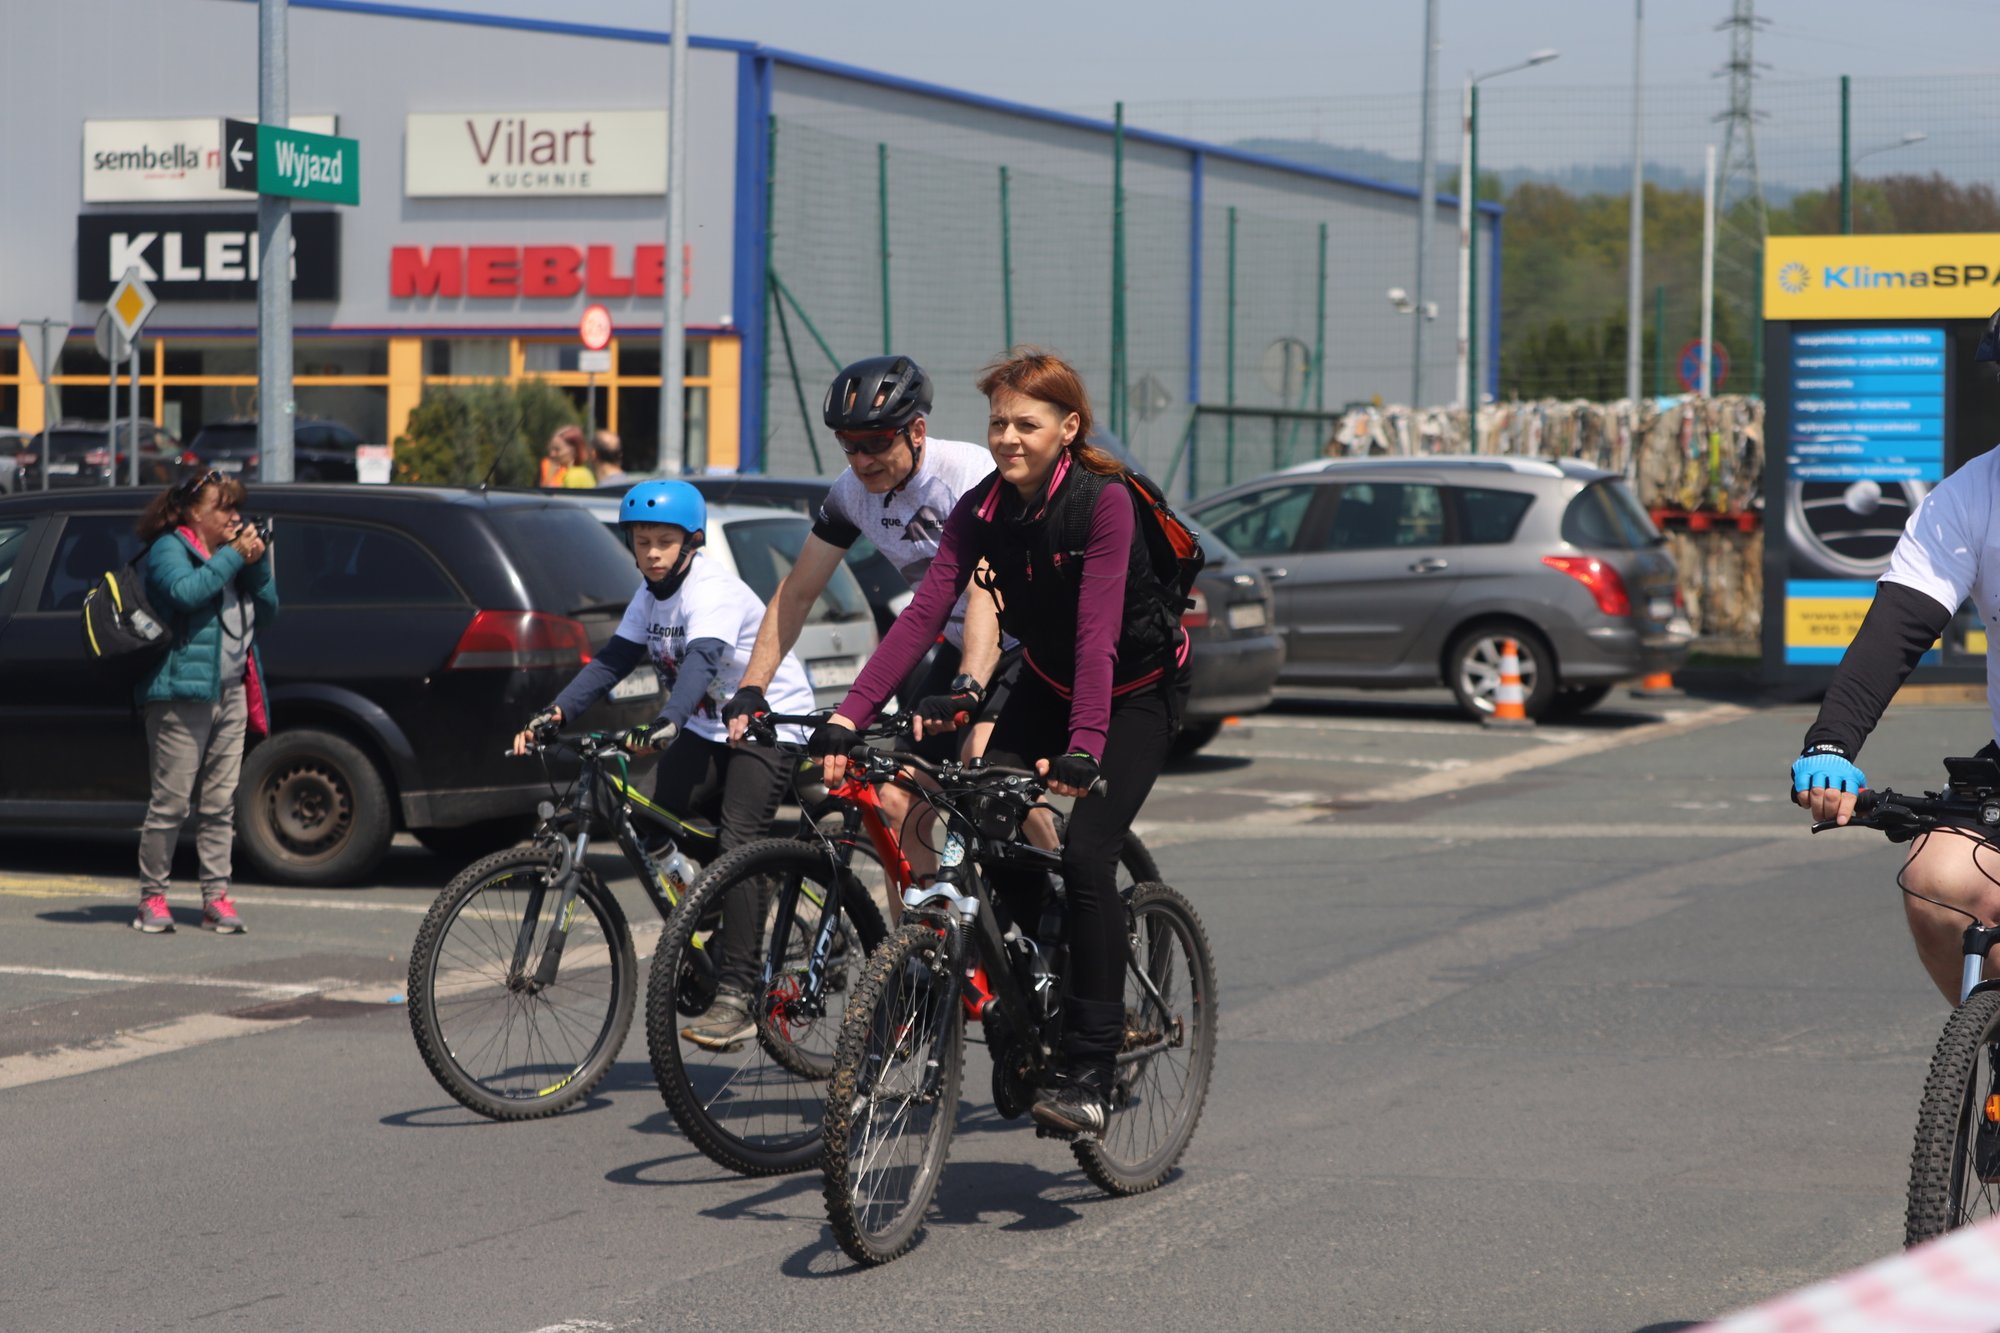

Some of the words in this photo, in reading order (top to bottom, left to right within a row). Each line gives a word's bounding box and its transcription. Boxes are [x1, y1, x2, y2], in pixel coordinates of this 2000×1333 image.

[93, 143, 199, 171] sembella
[274, 139, 343, 188] Wyjazd
[466, 118, 596, 166] Vilart
[487, 172, 593, 189] KUCHNIE
[388, 244, 692, 299] MEBLE
